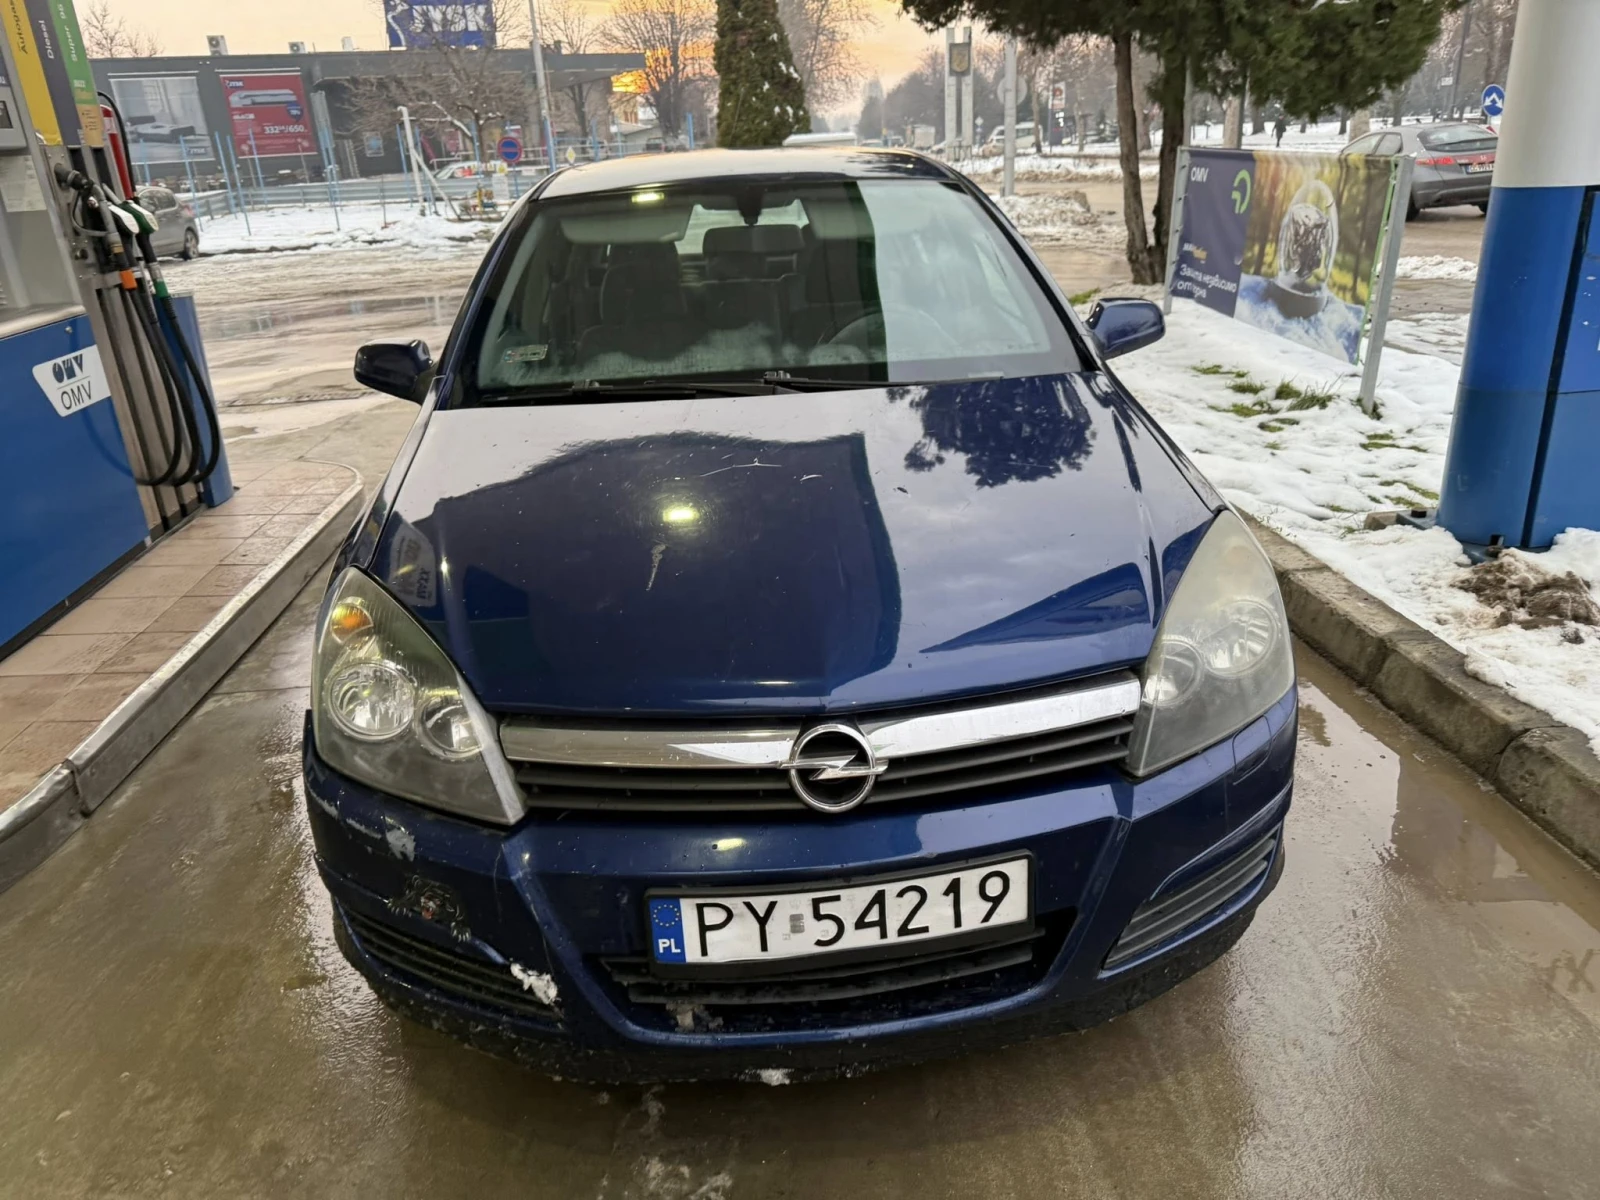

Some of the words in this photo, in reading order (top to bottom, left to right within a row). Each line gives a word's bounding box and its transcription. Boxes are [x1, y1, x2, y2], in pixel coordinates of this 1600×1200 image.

[38, 20, 55, 59] Diesel
[64, 25, 78, 62] Super
[1190, 167, 1209, 182] OMV
[52, 353, 83, 384] OMV
[61, 380, 92, 410] OMV
[695, 900, 778, 957] PY
[811, 870, 1011, 947] 54219
[658, 938, 681, 954] PL
